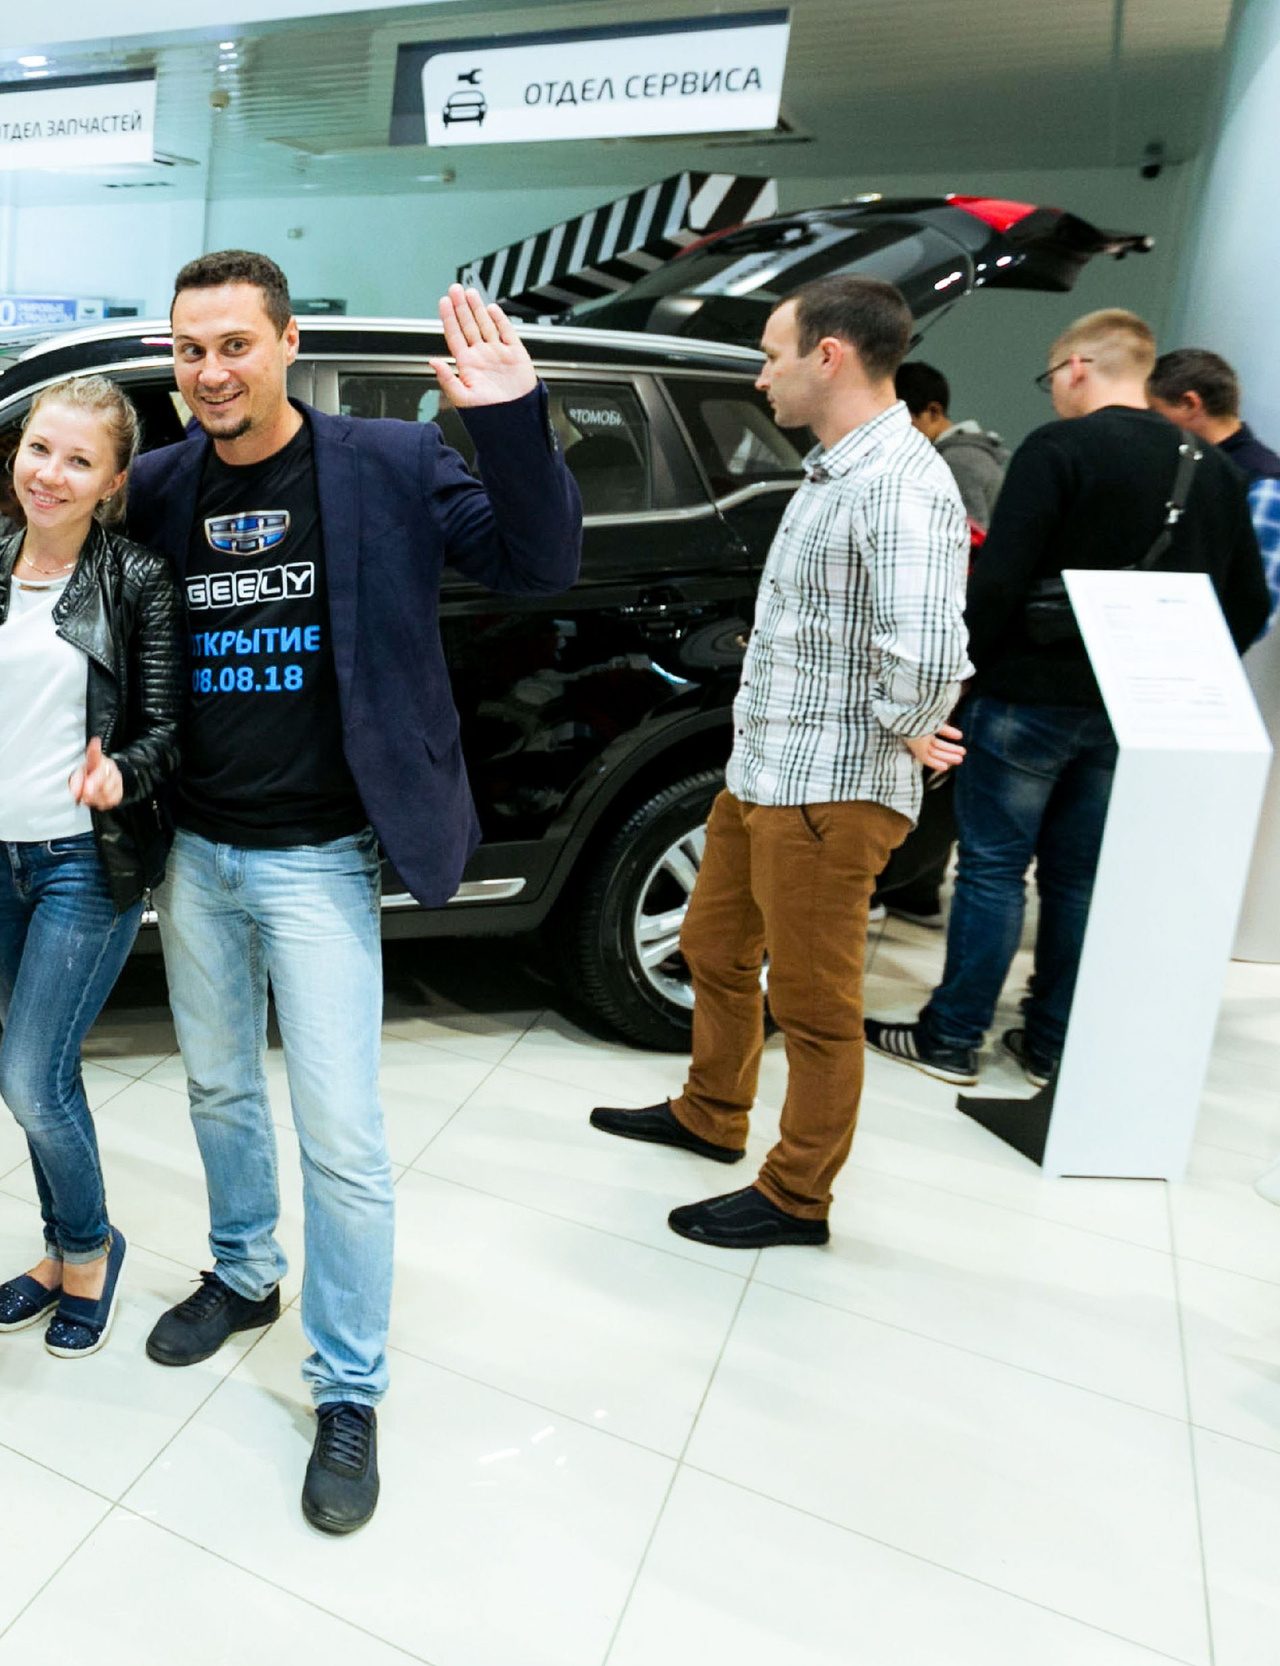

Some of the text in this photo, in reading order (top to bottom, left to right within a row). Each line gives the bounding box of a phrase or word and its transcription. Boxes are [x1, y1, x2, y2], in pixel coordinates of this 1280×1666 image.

[523, 66, 762, 107] ОТДЕЛ СЕРВИСА
[46, 110, 143, 137] ЗАПЧАСТЕЙ
[187, 566, 313, 606] GEELY
[193, 665, 304, 693] 08.08.18
